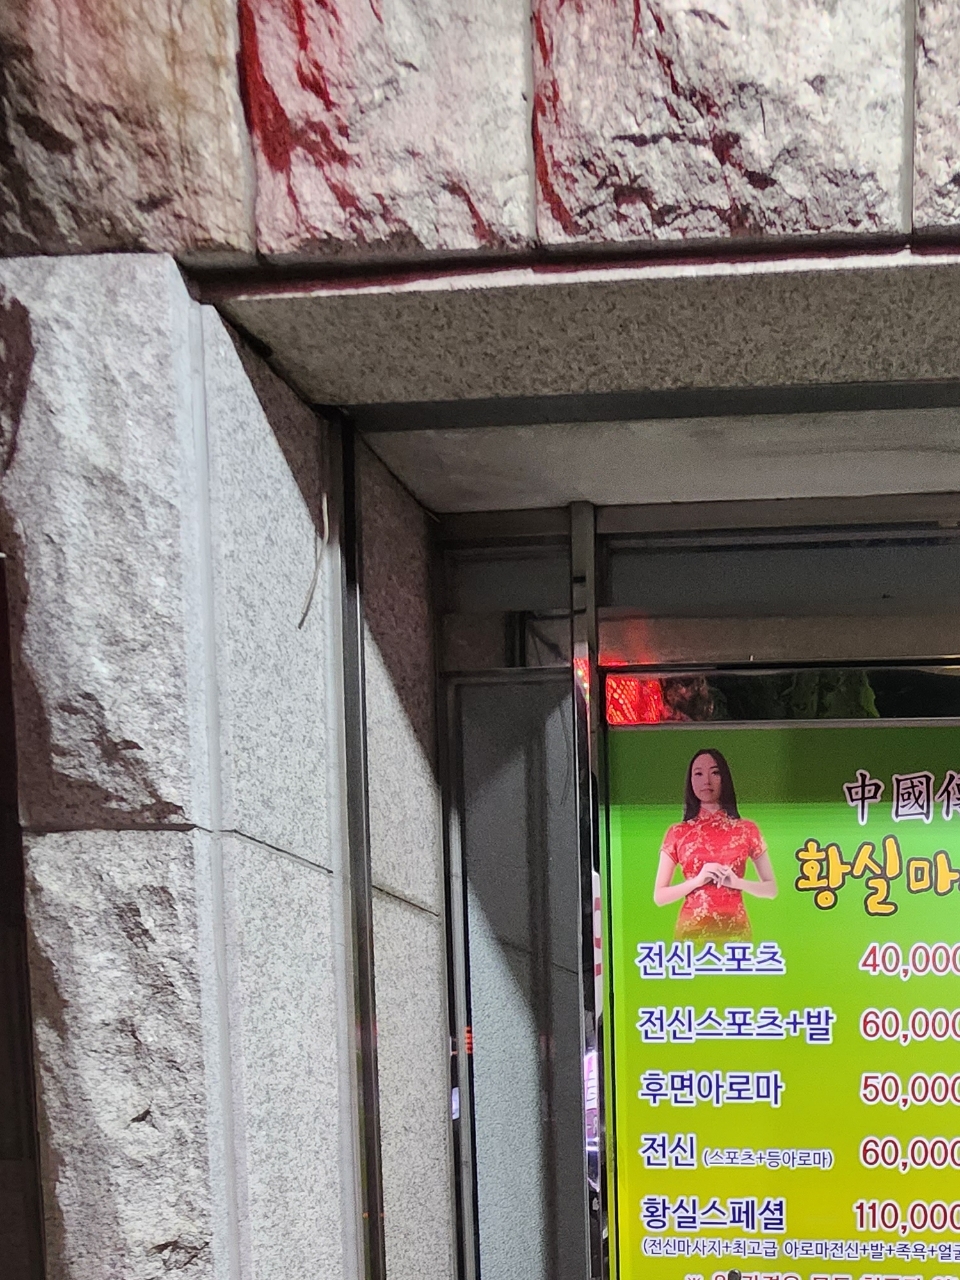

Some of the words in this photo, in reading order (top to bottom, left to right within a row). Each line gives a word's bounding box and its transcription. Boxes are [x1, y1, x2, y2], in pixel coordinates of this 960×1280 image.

[636, 942, 786, 976] 전신스포츠
[637, 1008, 835, 1043] 전신스포츠+발
[640, 1072, 783, 1107] 후면아로마
[640, 1135, 696, 1167] 전신
[703, 1149, 834, 1169] (스포츠+등아로마)
[642, 1196, 786, 1232] 황실스페셜
[642, 1238, 779, 1258] (전신마사지+최고급
